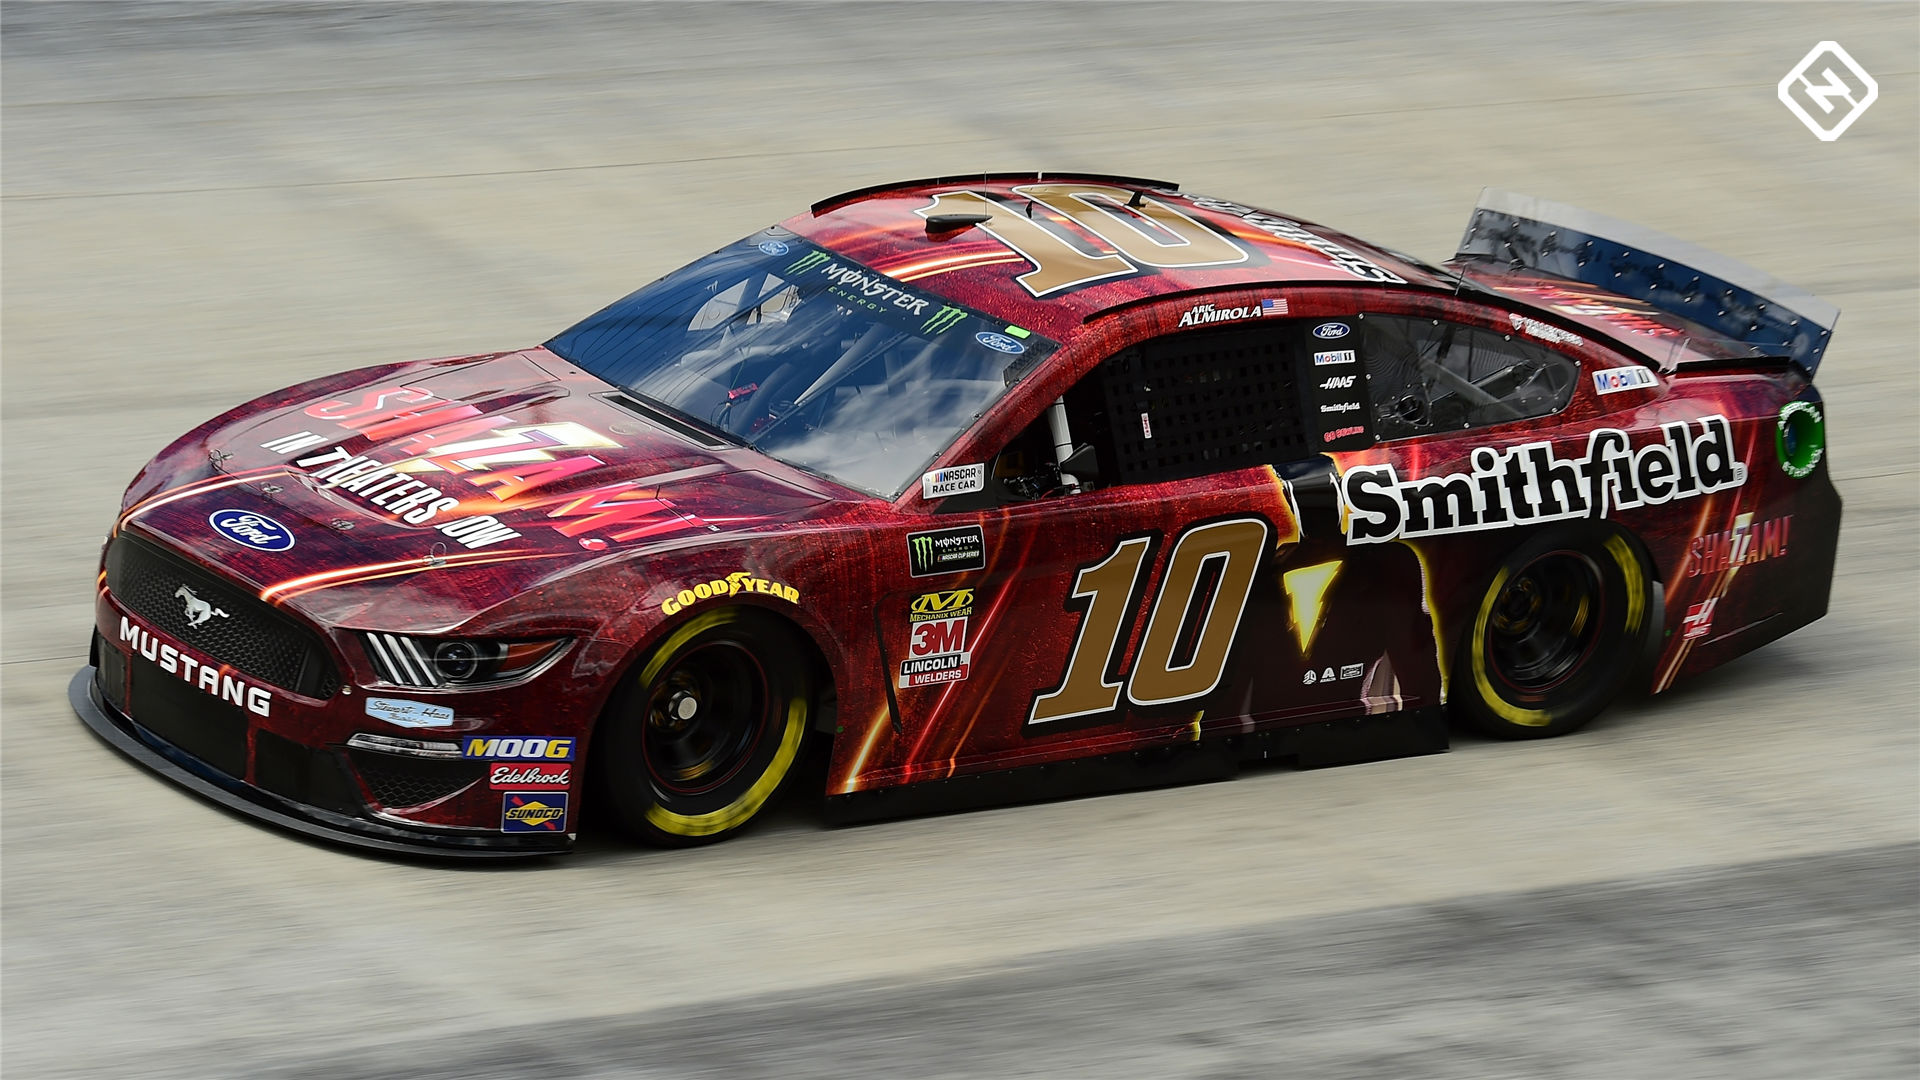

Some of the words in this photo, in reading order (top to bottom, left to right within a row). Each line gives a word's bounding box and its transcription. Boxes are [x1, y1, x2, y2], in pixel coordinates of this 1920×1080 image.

[914, 183, 1249, 298] 10
[821, 263, 929, 316] MONSTER
[827, 286, 888, 314] ENERGY
[1191, 303, 1216, 315] ARIC
[1178, 306, 1264, 327] ALMIROLA
[1318, 323, 1345, 337] Ford
[981, 335, 1020, 353] Ford
[1315, 353, 1342, 365] Mobil
[1320, 375, 1357, 390] HAAS
[1320, 402, 1361, 413] Smithfield
[260, 430, 329, 455] IN
[943, 467, 977, 482] NASCAR
[1345, 414, 1738, 546] Smithfield
[932, 482, 956, 494] RACE
[957, 480, 976, 491] CAR
[219, 514, 284, 547] Ford
[935, 535, 980, 548] MONSTER
[661, 572, 800, 615] GOODYEAR
[909, 612, 949, 622] MECHANIX
[950, 606, 973, 617] WEAR
[1028, 517, 1267, 725] 10
[911, 619, 967, 656] 3M
[120, 616, 272, 718] MUSTANG
[903, 656, 958, 675] LINCOLN
[912, 669, 962, 685] WELDERS
[466, 739, 572, 758] MOOG
[489, 766, 570, 785] Edelbrock
[508, 808, 561, 820] SUNOCO
